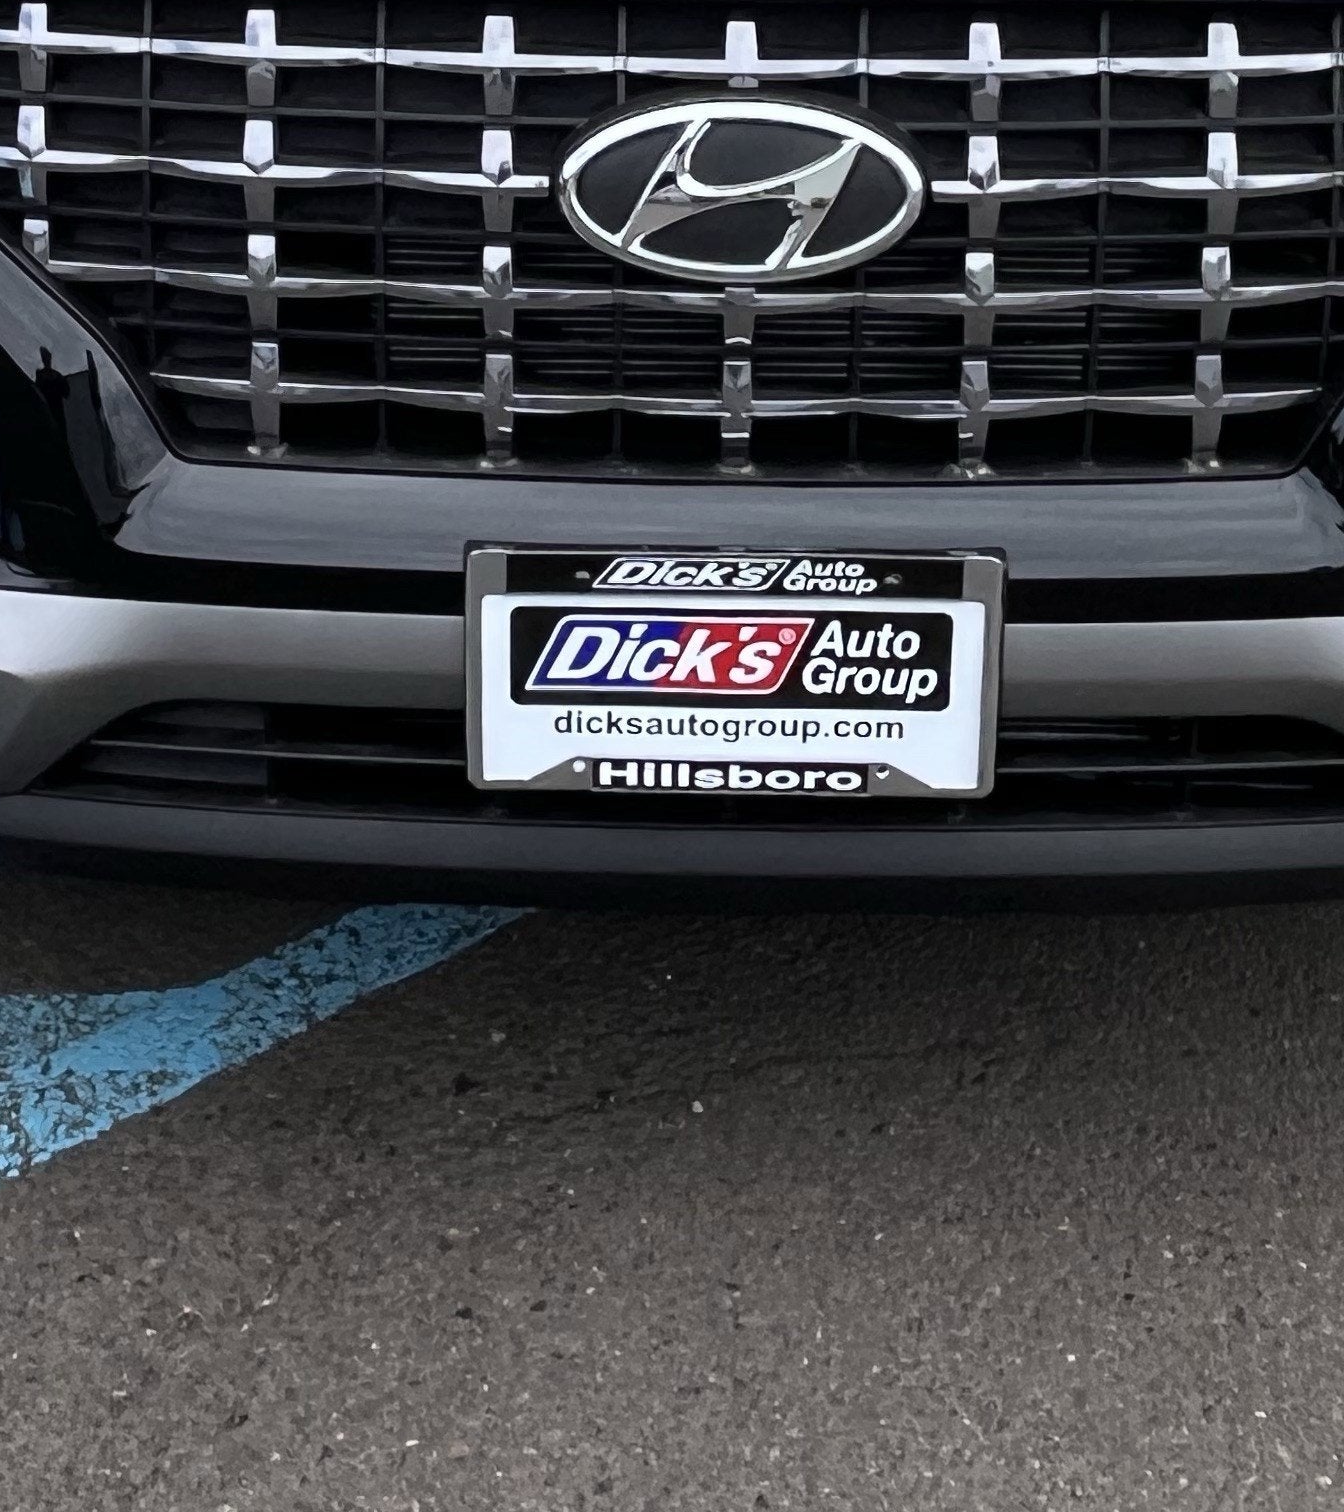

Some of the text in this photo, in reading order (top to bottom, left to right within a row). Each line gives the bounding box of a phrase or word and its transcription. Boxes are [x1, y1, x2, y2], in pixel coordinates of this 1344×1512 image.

[789, 560, 865, 577] Auto
[783, 577, 878, 595] Group
[811, 619, 921, 660] Auto
[802, 656, 938, 704] Group
[554, 710, 905, 744] dicksautogroup.com
[599, 761, 863, 791] Hillsboro
